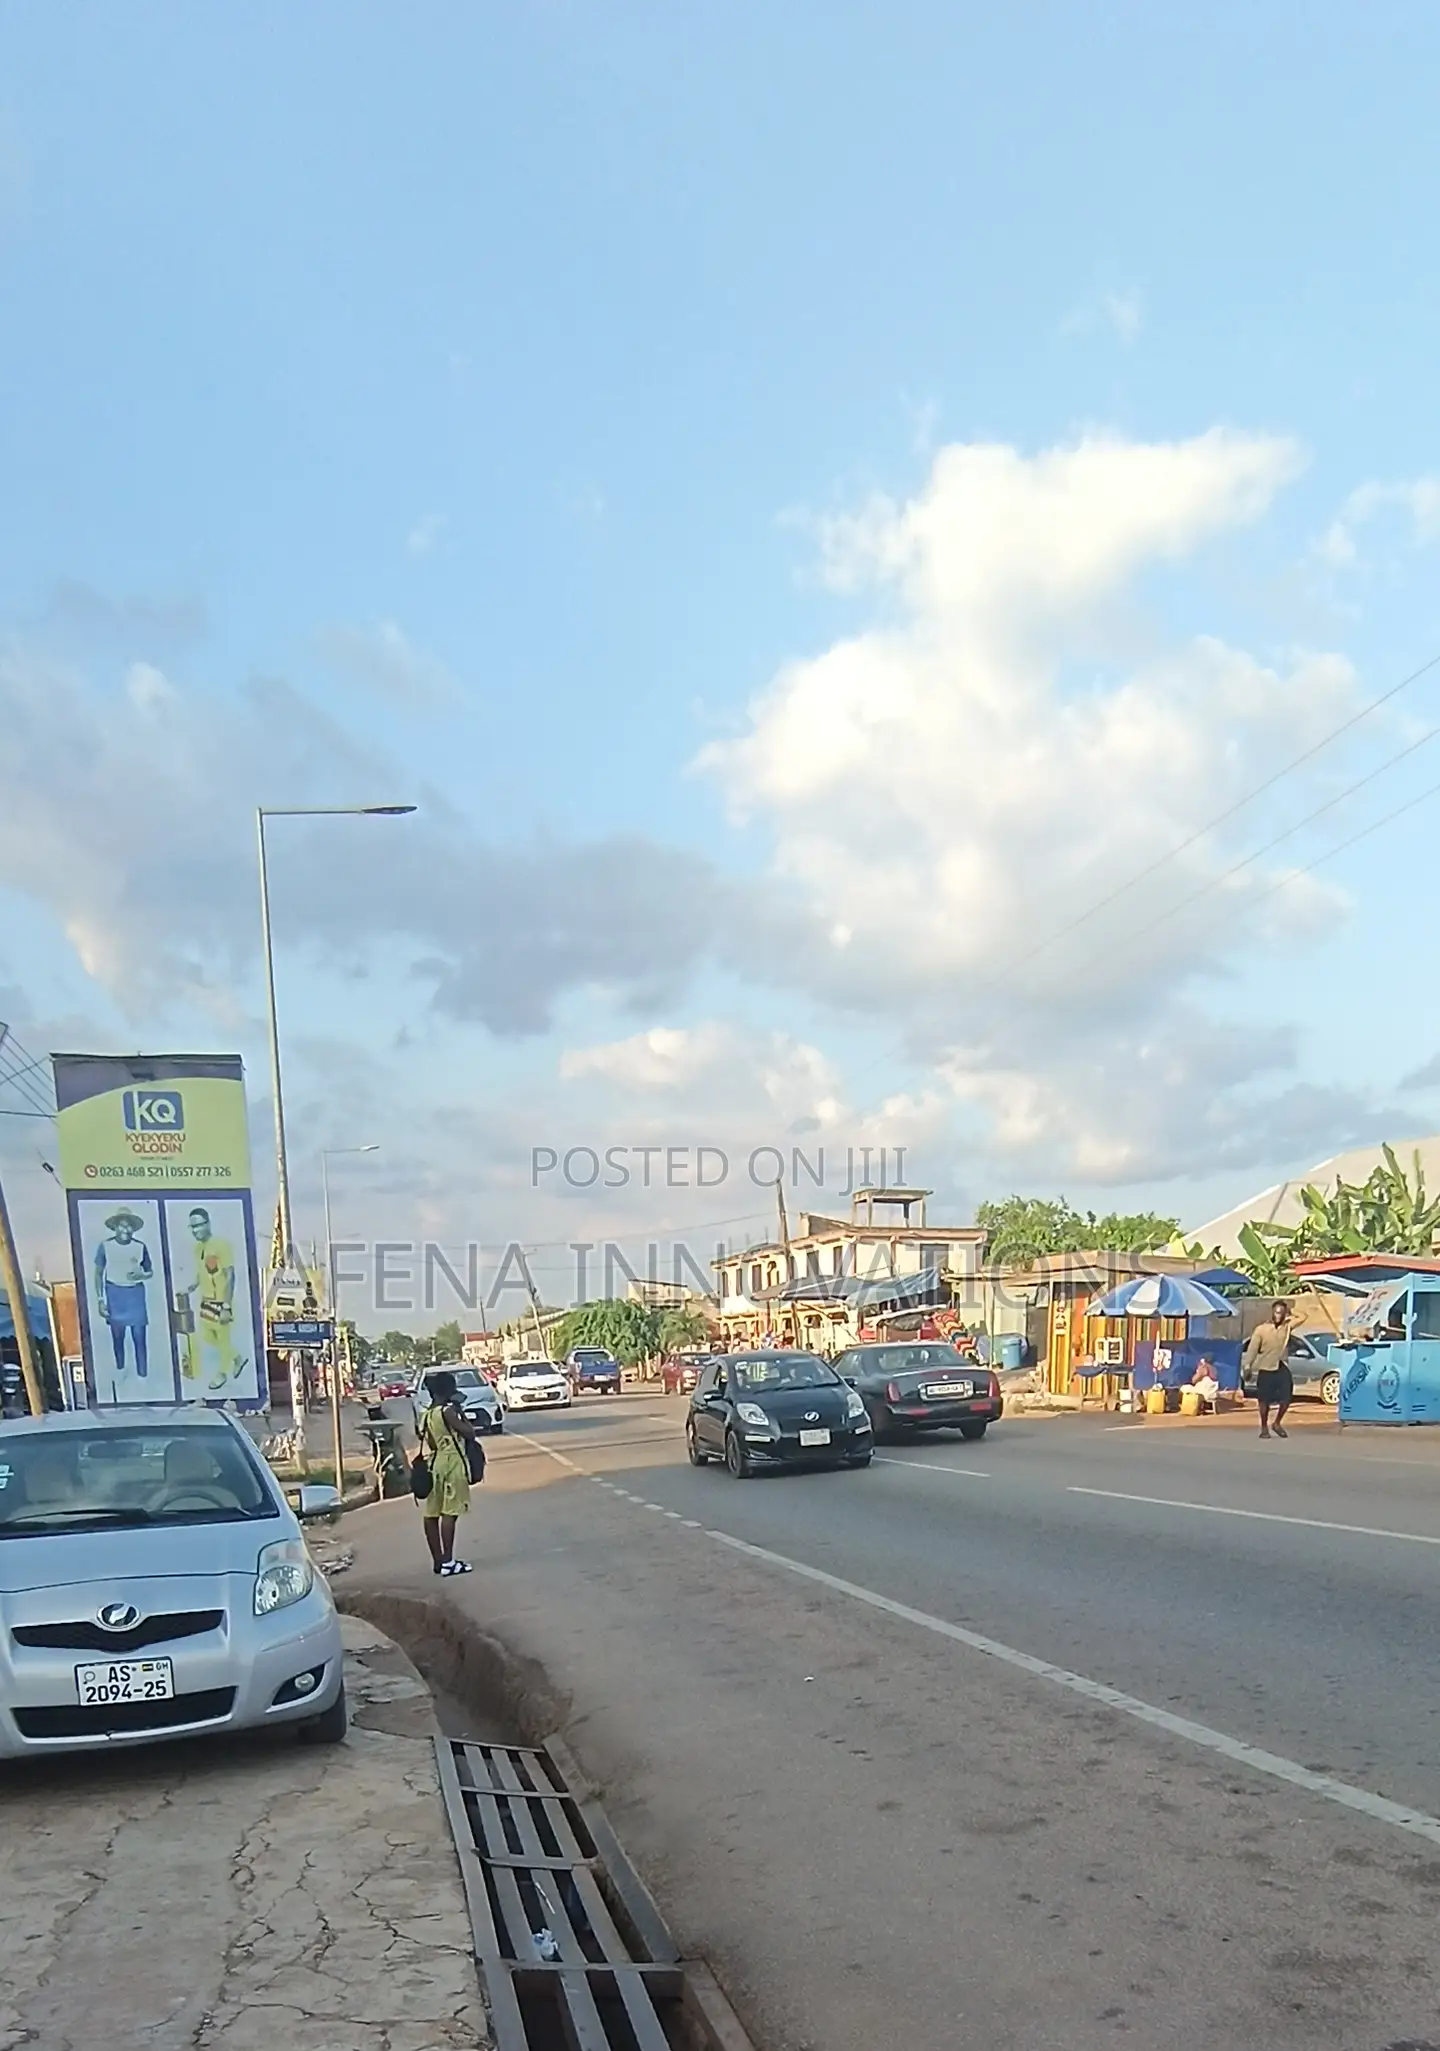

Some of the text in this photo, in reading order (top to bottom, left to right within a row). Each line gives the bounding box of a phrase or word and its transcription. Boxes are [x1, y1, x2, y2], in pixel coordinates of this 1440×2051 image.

[132, 1091, 177, 1131] KQ
[125, 1132, 186, 1143] KYEKYEKU
[132, 1142, 183, 1154] QLODIN
[99, 1166, 125, 1178] 0263
[147, 1166, 164, 1178] 521
[213, 1166, 232, 1177] 326
[108, 1665, 131, 1682] AS
[85, 1680, 167, 1703] 2094-25
